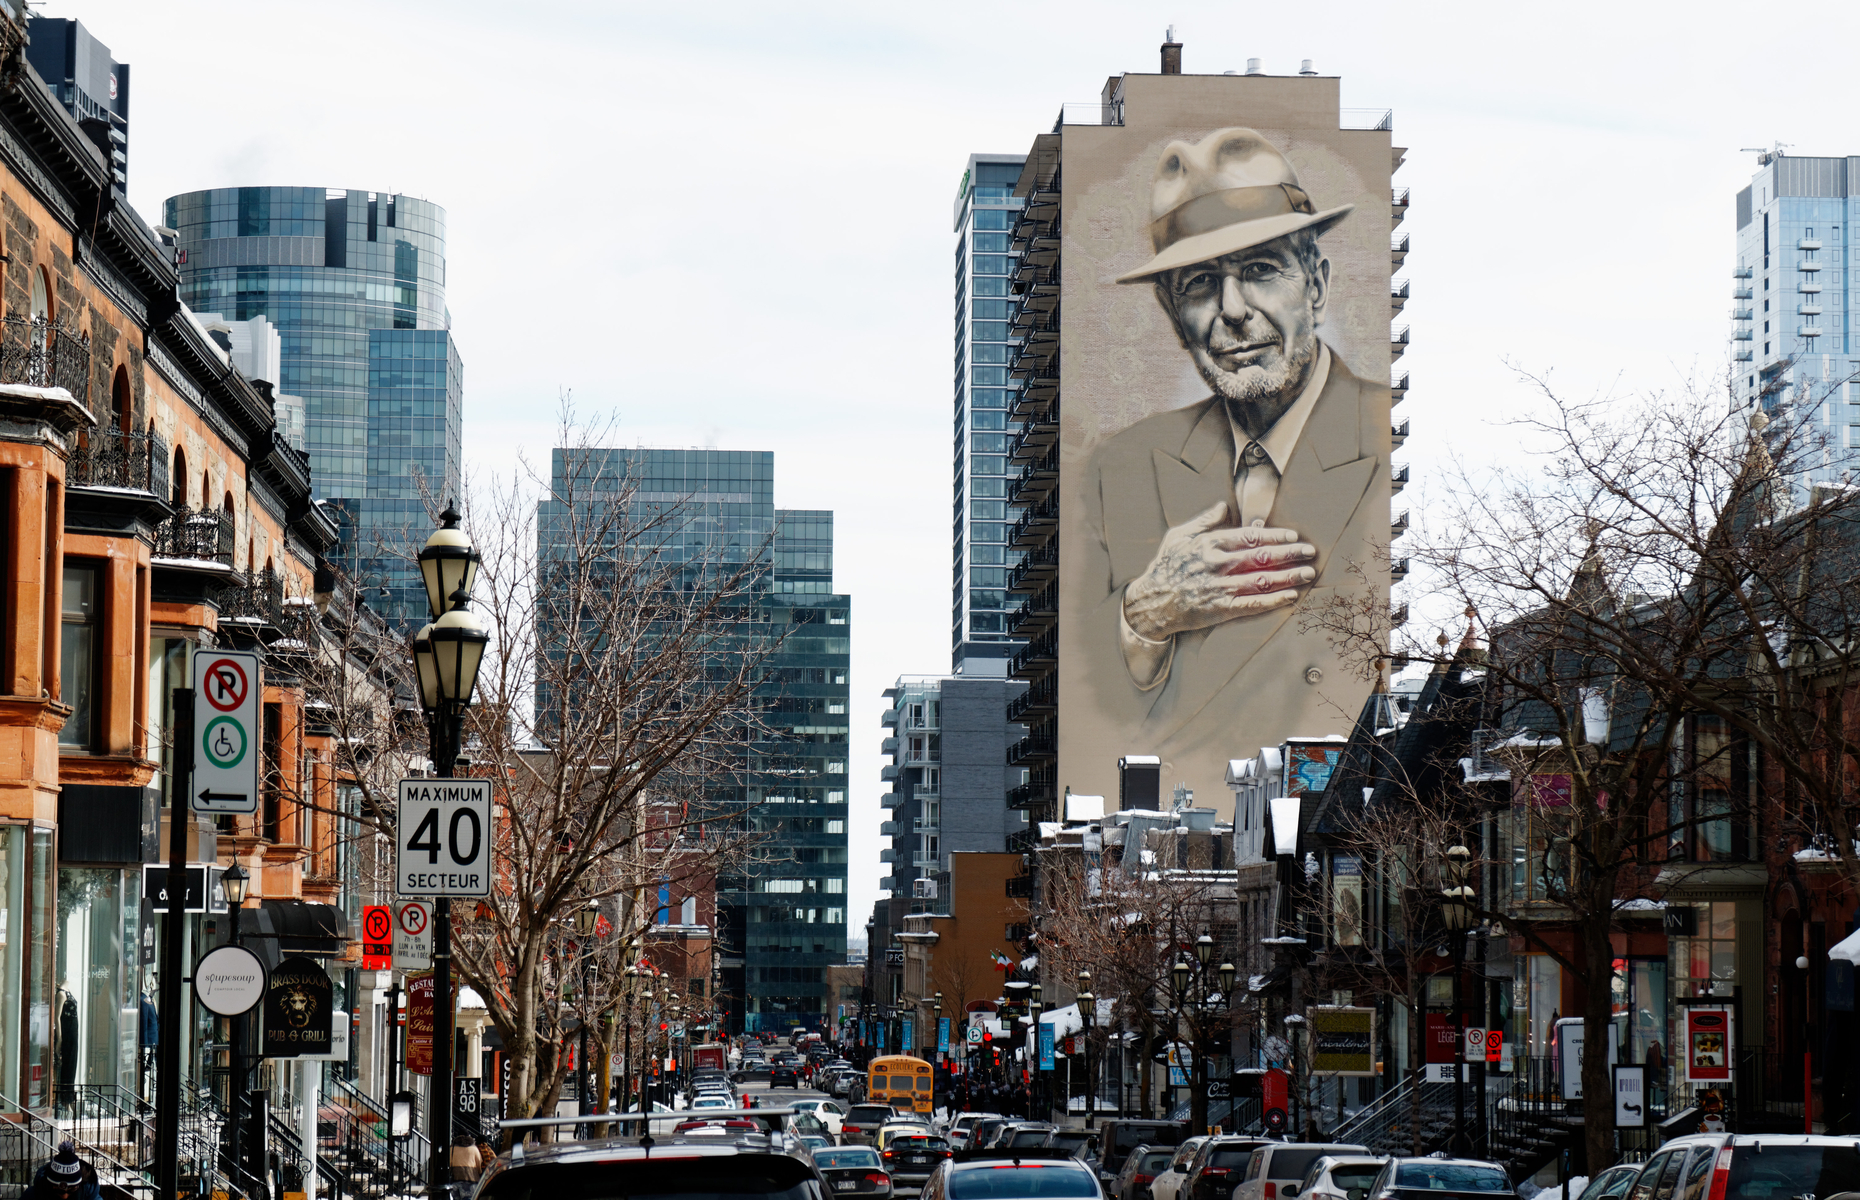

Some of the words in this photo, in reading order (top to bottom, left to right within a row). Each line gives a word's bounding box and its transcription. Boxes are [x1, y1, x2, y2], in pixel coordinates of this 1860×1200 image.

[407, 787, 482, 802] MAXIMUM
[407, 807, 481, 866] 40
[407, 873, 479, 888] SECTEUR
[204, 973, 255, 988] soupesoup
[270, 974, 300, 990] BRASS
[301, 974, 329, 990] DOOR
[268, 1030, 286, 1042] PUB
[288, 1030, 299, 1042] &
[301, 1030, 327, 1042] GRILL
[1437, 1031, 1456, 1043] LÉGE
[459, 1080, 477, 1094] A.S.
[459, 1094, 477, 1113] 98
